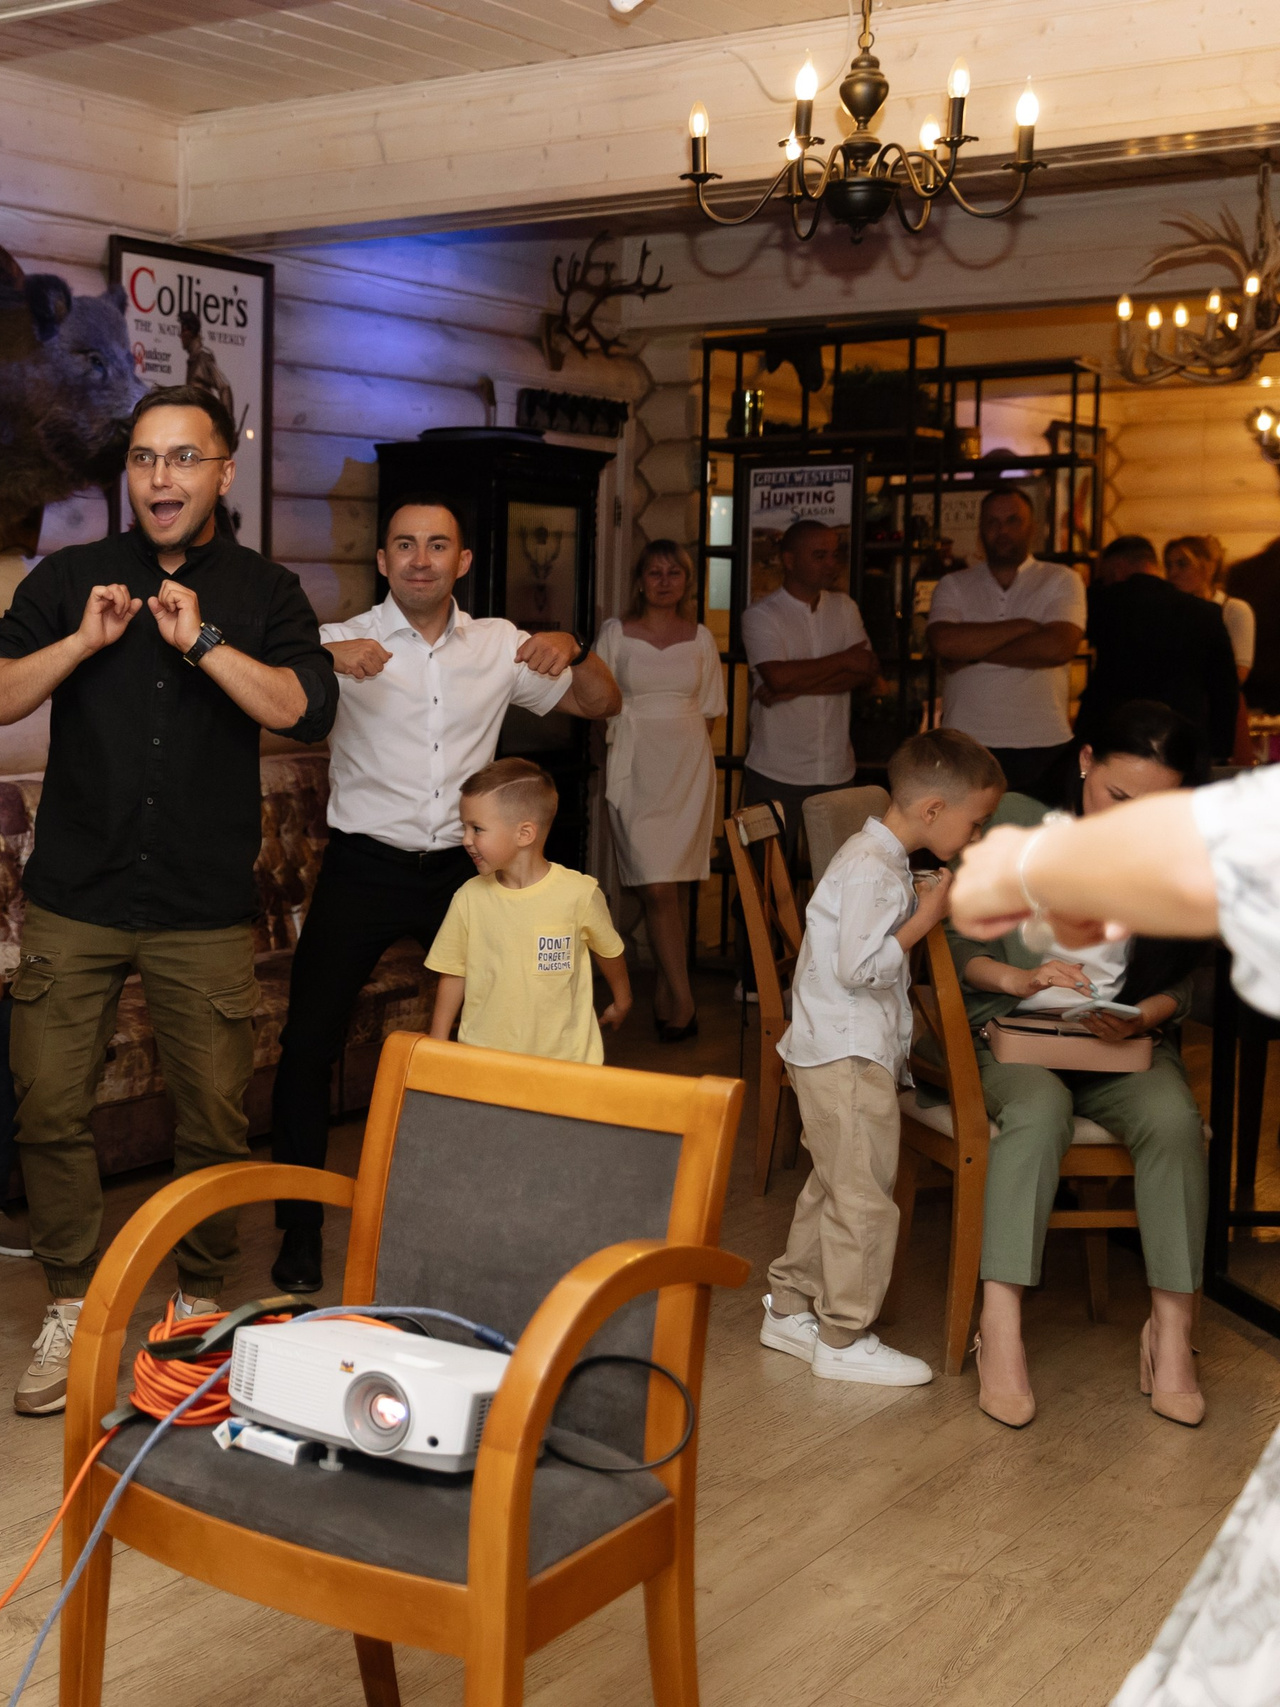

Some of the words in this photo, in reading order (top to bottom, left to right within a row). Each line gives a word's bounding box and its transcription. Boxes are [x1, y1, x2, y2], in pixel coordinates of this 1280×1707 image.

[129, 266, 248, 328] Collier's
[134, 319, 152, 334] THE
[207, 331, 247, 347] WEEKLY
[755, 473, 791, 485] GREAT
[793, 469, 849, 484] WESTERN
[760, 490, 835, 510] HUNTING
[791, 506, 835, 517] SEASON
[539, 936, 571, 951] DON'T
[538, 952, 565, 961] FORGET
[538, 961, 571, 971] AWESOME
